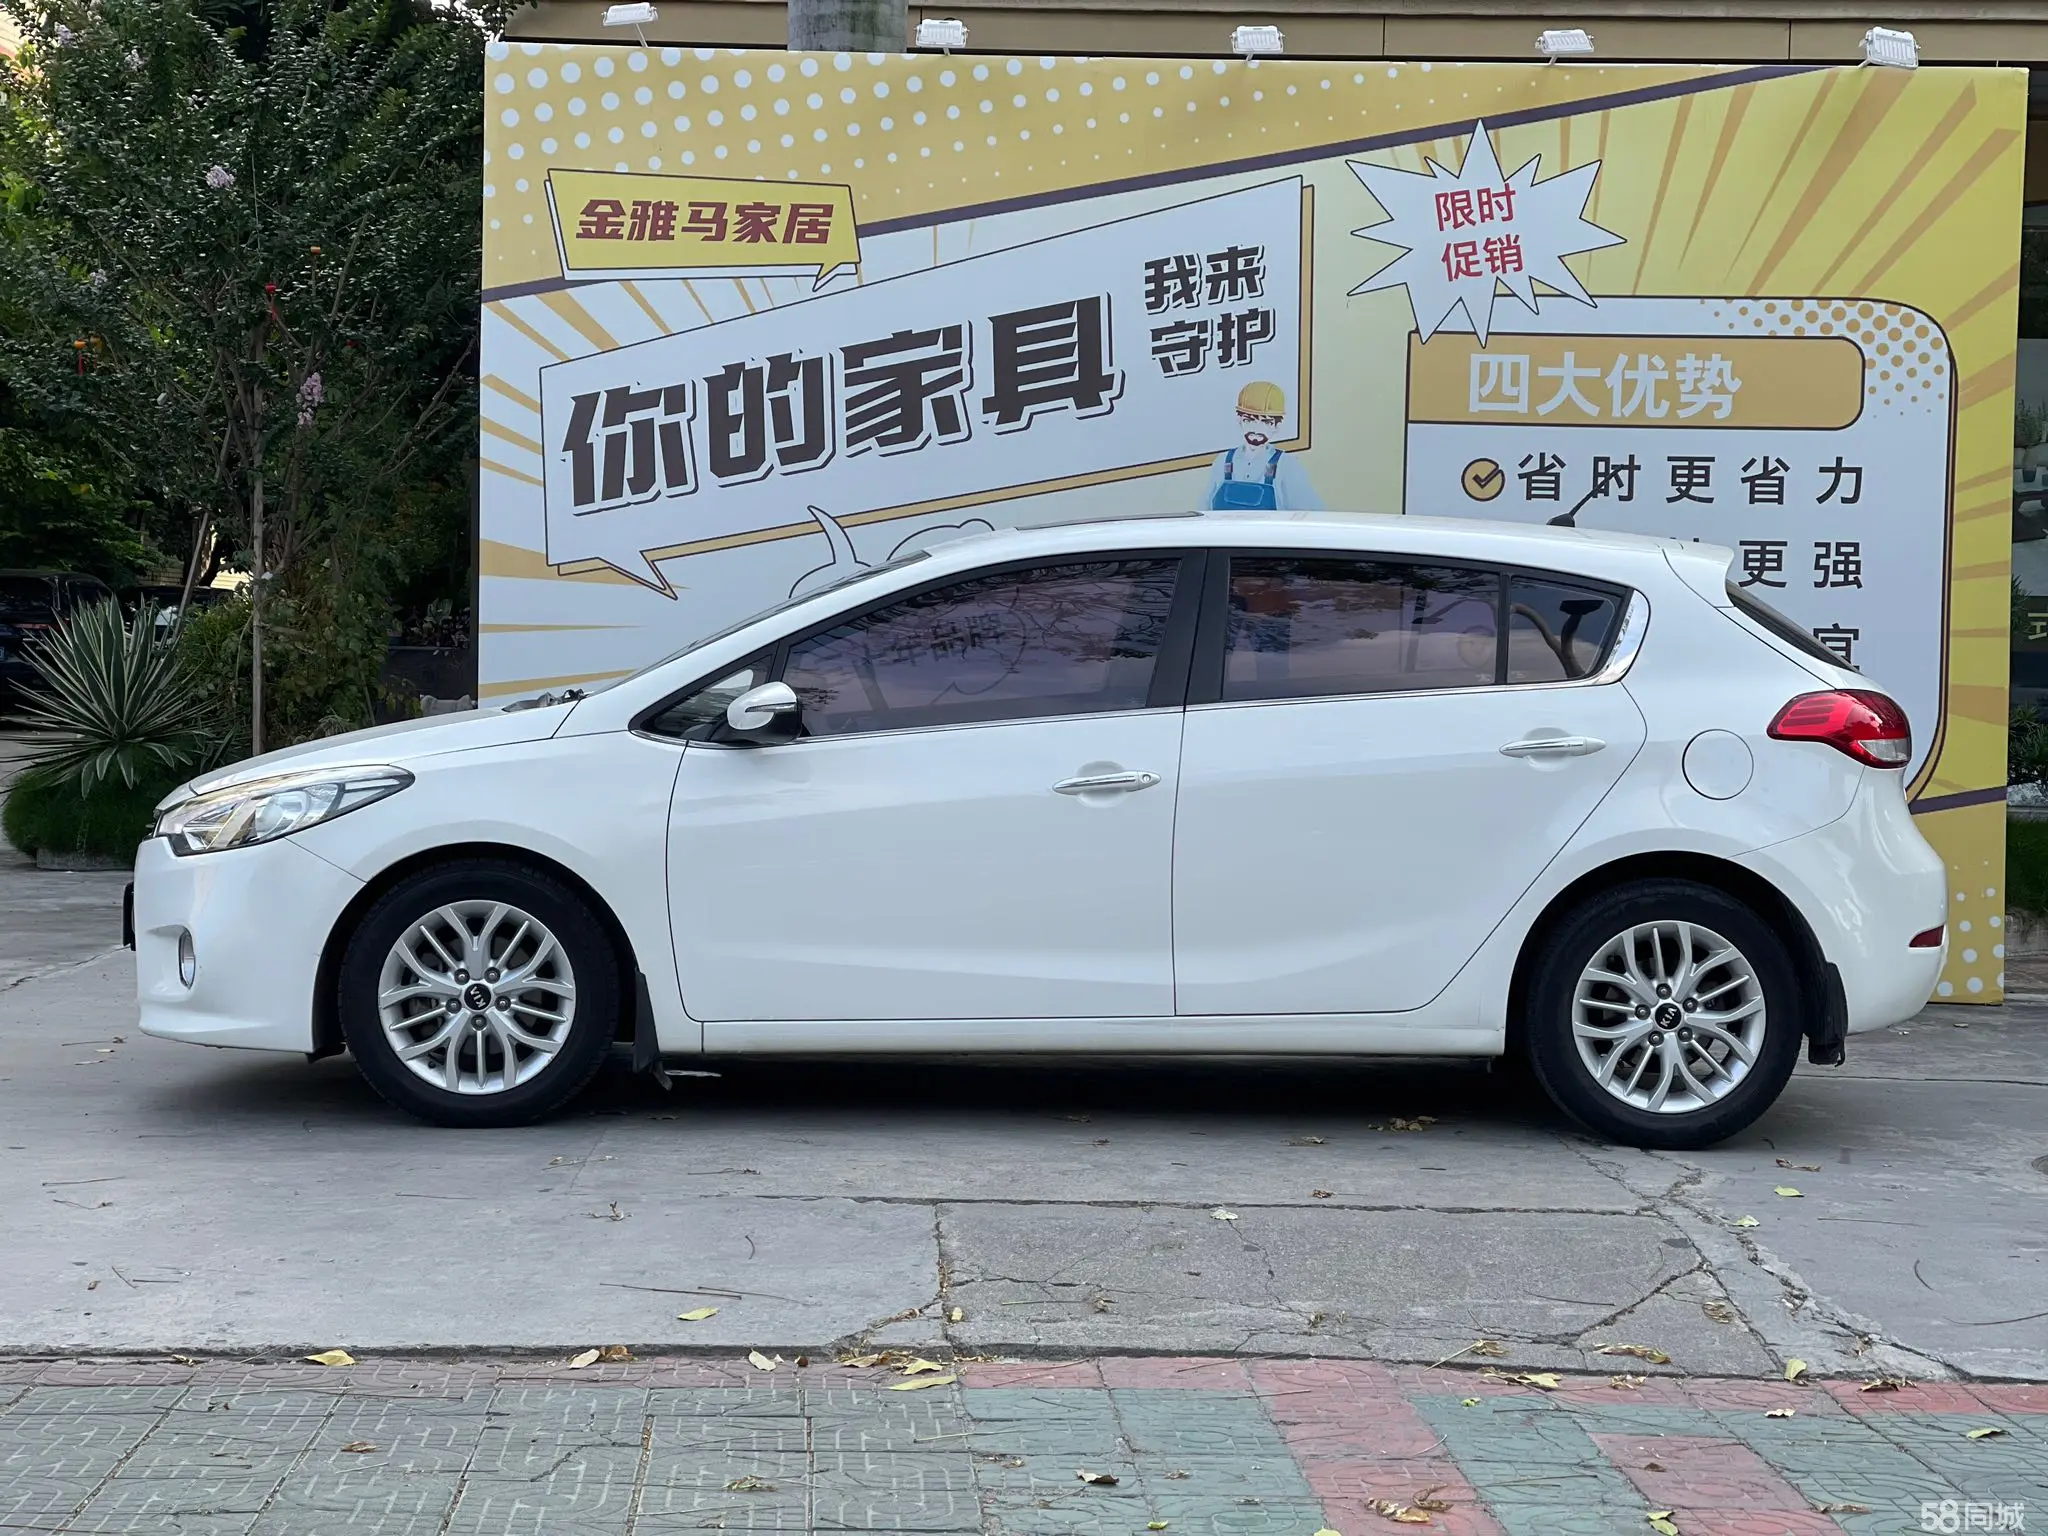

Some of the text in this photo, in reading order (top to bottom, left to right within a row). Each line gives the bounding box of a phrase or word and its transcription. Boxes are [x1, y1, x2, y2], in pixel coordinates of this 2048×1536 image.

[575, 199, 834, 246] 金雅马家居
[1435, 182, 1517, 231] 限时
[1144, 244, 1266, 315] 我来
[1440, 234, 1525, 283] 促销
[1151, 307, 1277, 377] 守护
[560, 292, 1125, 515] 你的家具
[1467, 351, 1743, 421] 四大优势
[1516, 451, 1865, 507] 省时更省力
